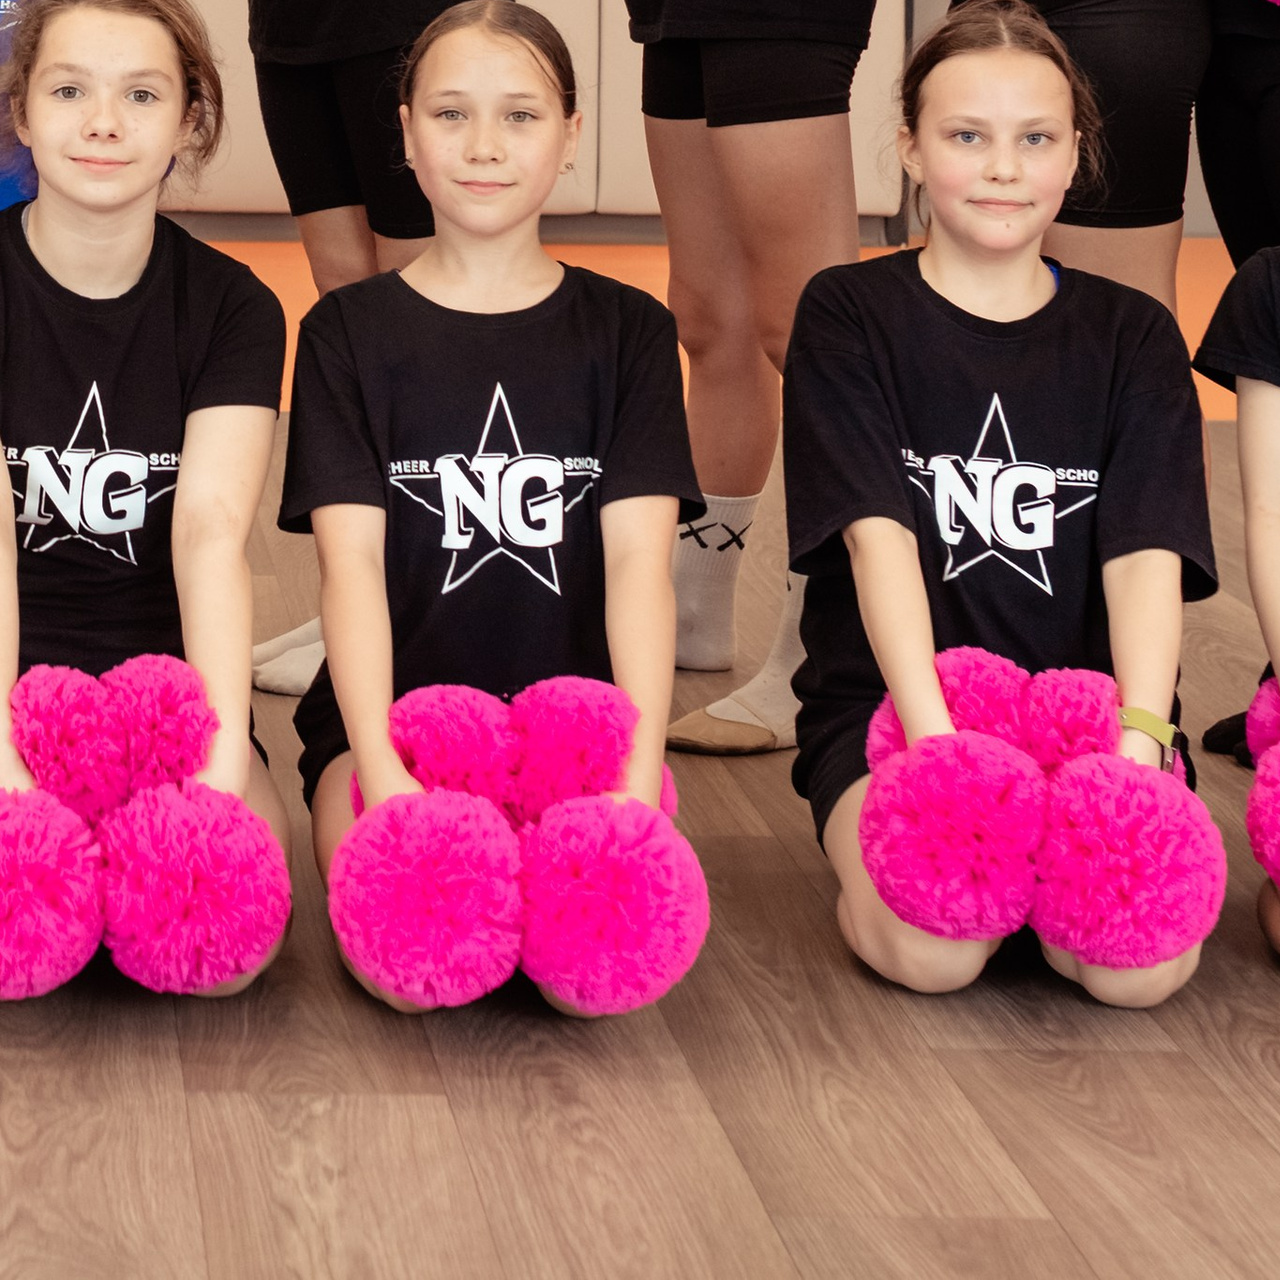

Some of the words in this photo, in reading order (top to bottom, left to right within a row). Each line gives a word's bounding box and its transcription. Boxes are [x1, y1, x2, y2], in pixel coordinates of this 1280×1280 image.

[16, 445, 149, 535] NG
[388, 459, 431, 475] HEER
[433, 453, 564, 549] NG
[926, 453, 1057, 551] NG
